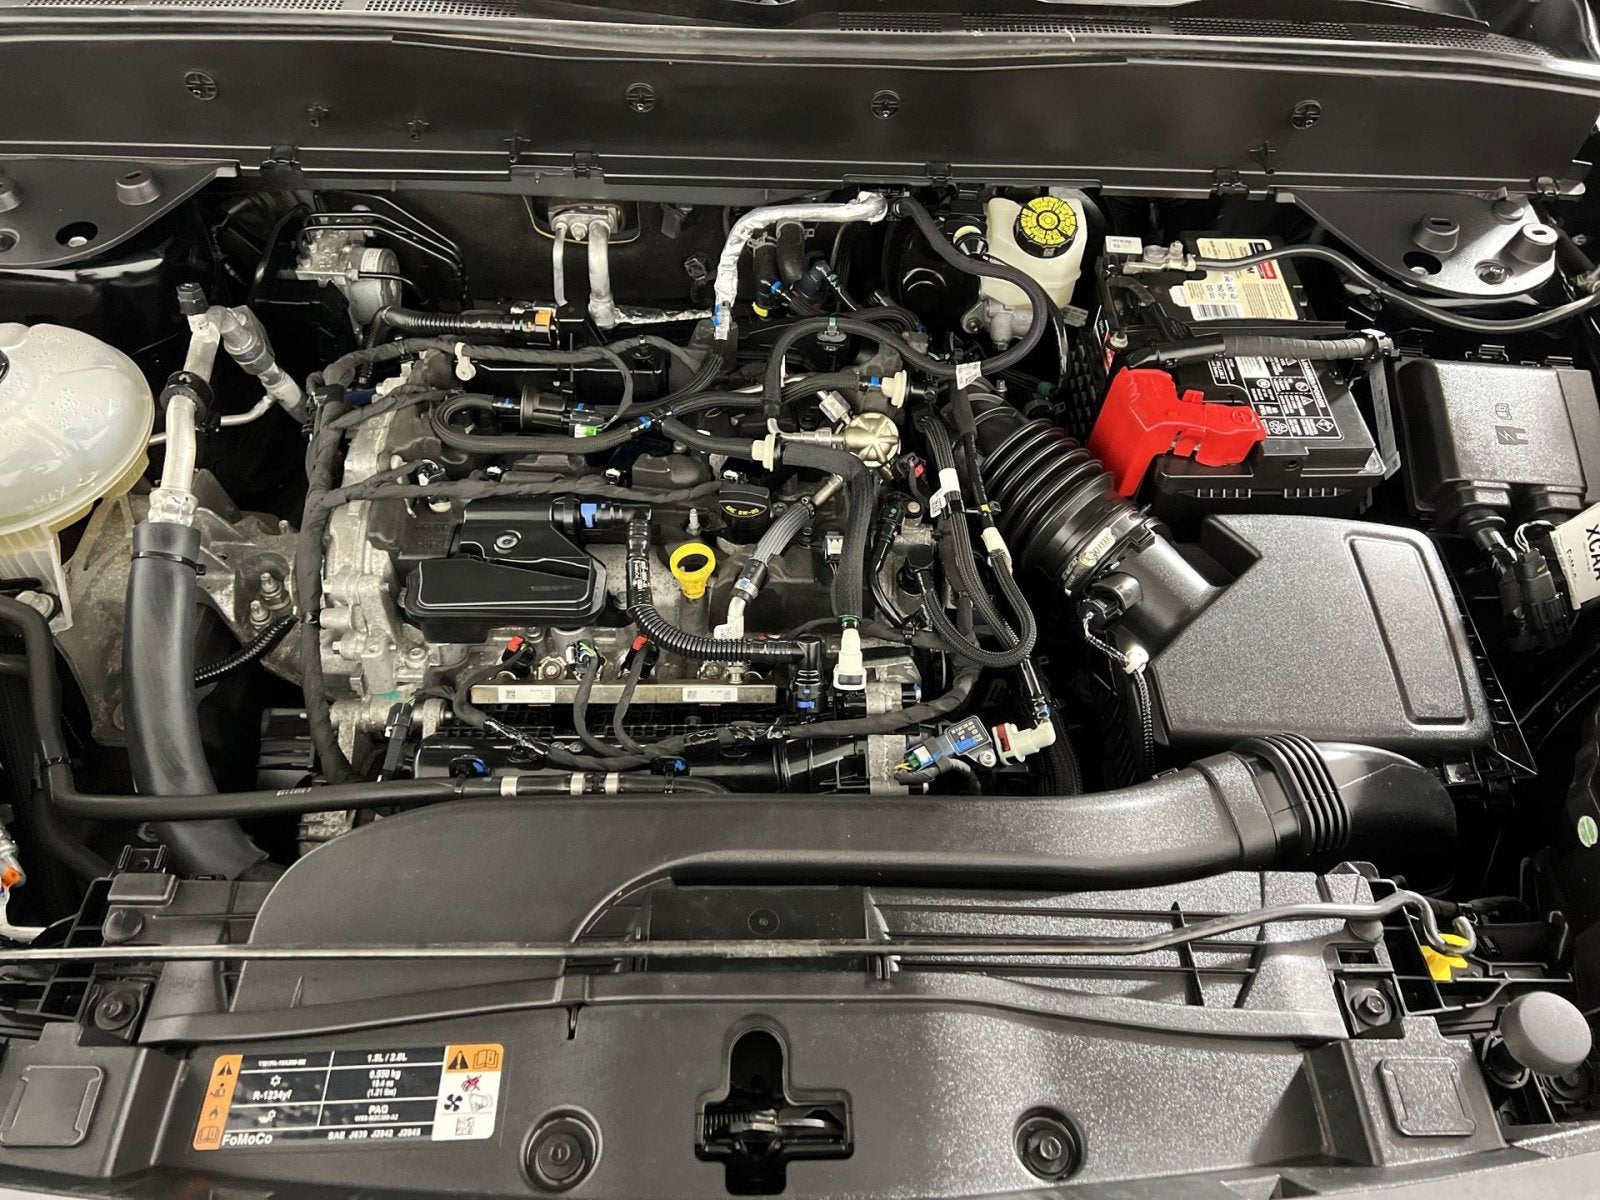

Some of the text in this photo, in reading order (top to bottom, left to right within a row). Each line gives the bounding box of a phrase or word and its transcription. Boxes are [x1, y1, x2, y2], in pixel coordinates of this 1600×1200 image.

[390, 1069, 402, 1080] kg
[252, 1089, 293, 1101] R-1234yf
[222, 1132, 273, 1146] FoMoCo
[327, 1131, 346, 1141] SAE
